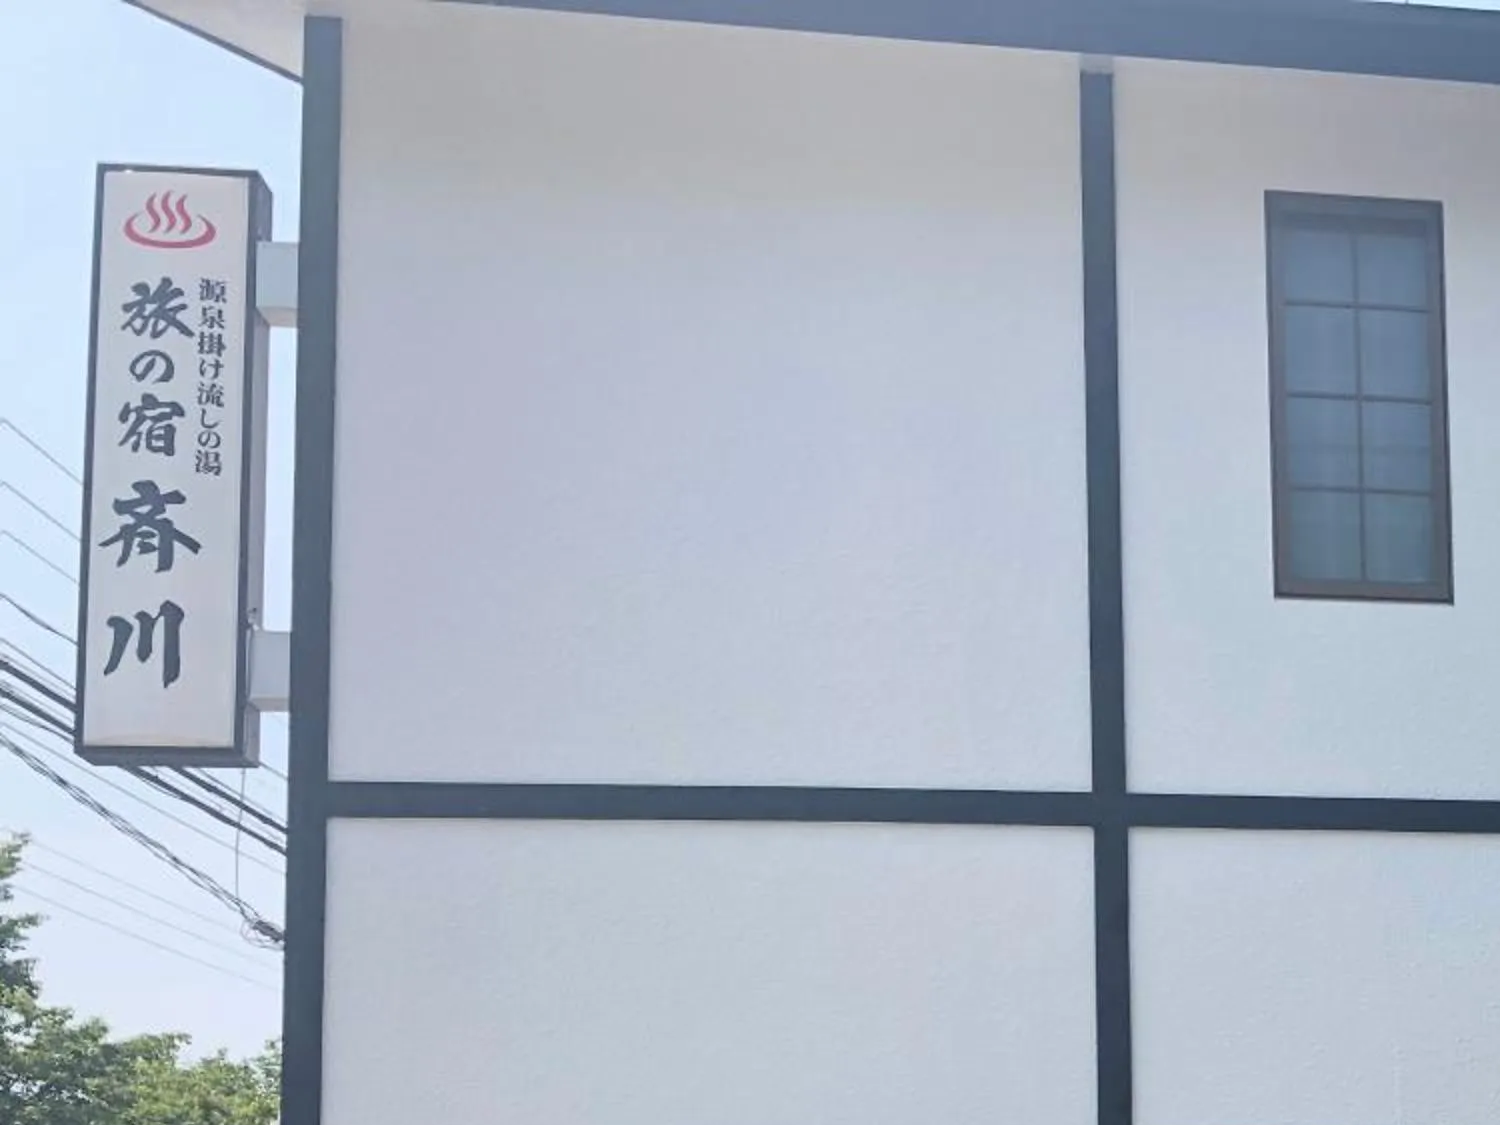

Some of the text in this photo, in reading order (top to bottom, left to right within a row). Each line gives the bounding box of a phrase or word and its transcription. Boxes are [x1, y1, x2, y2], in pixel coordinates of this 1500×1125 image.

[195, 277, 227, 477] 源泉掛け流しの湯
